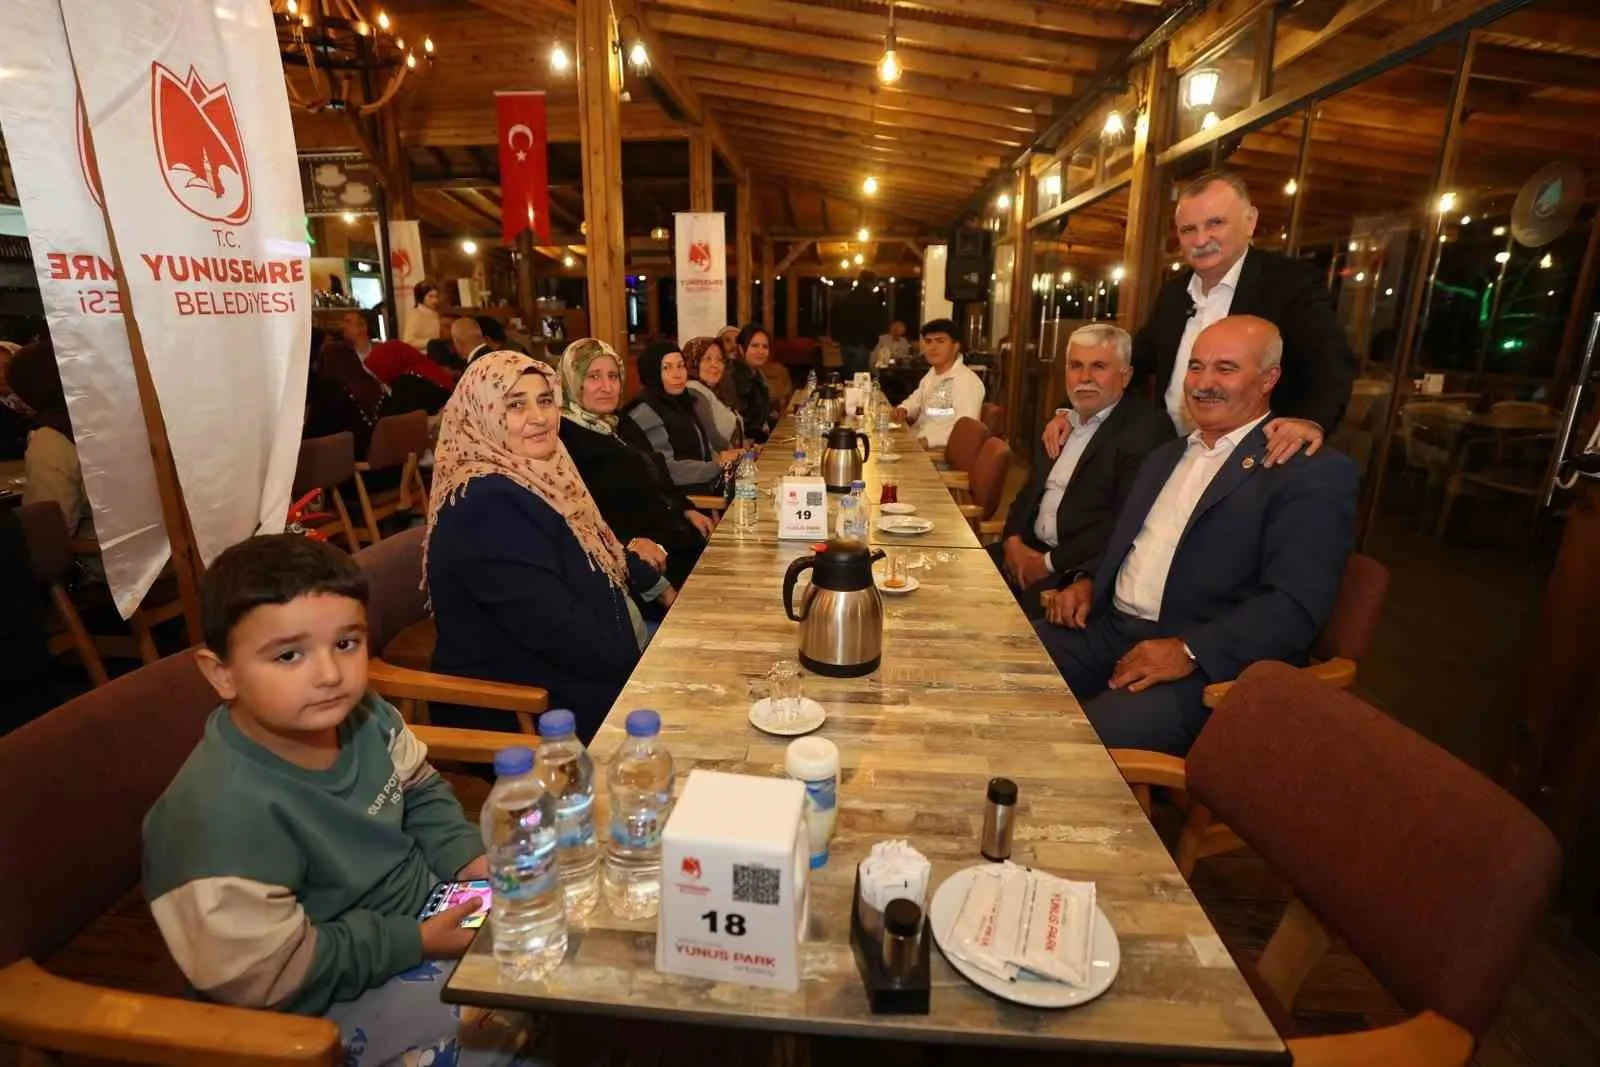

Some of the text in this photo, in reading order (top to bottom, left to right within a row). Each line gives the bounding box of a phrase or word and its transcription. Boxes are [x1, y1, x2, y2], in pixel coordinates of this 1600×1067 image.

[212, 229, 241, 248] T.C.
[140, 253, 304, 284] YUNUSEMRE
[174, 291, 296, 316] BELEDİYESİ
[795, 510, 812, 520] 19
[701, 910, 746, 936] 18
[675, 943, 776, 967] YUNUS PARK
